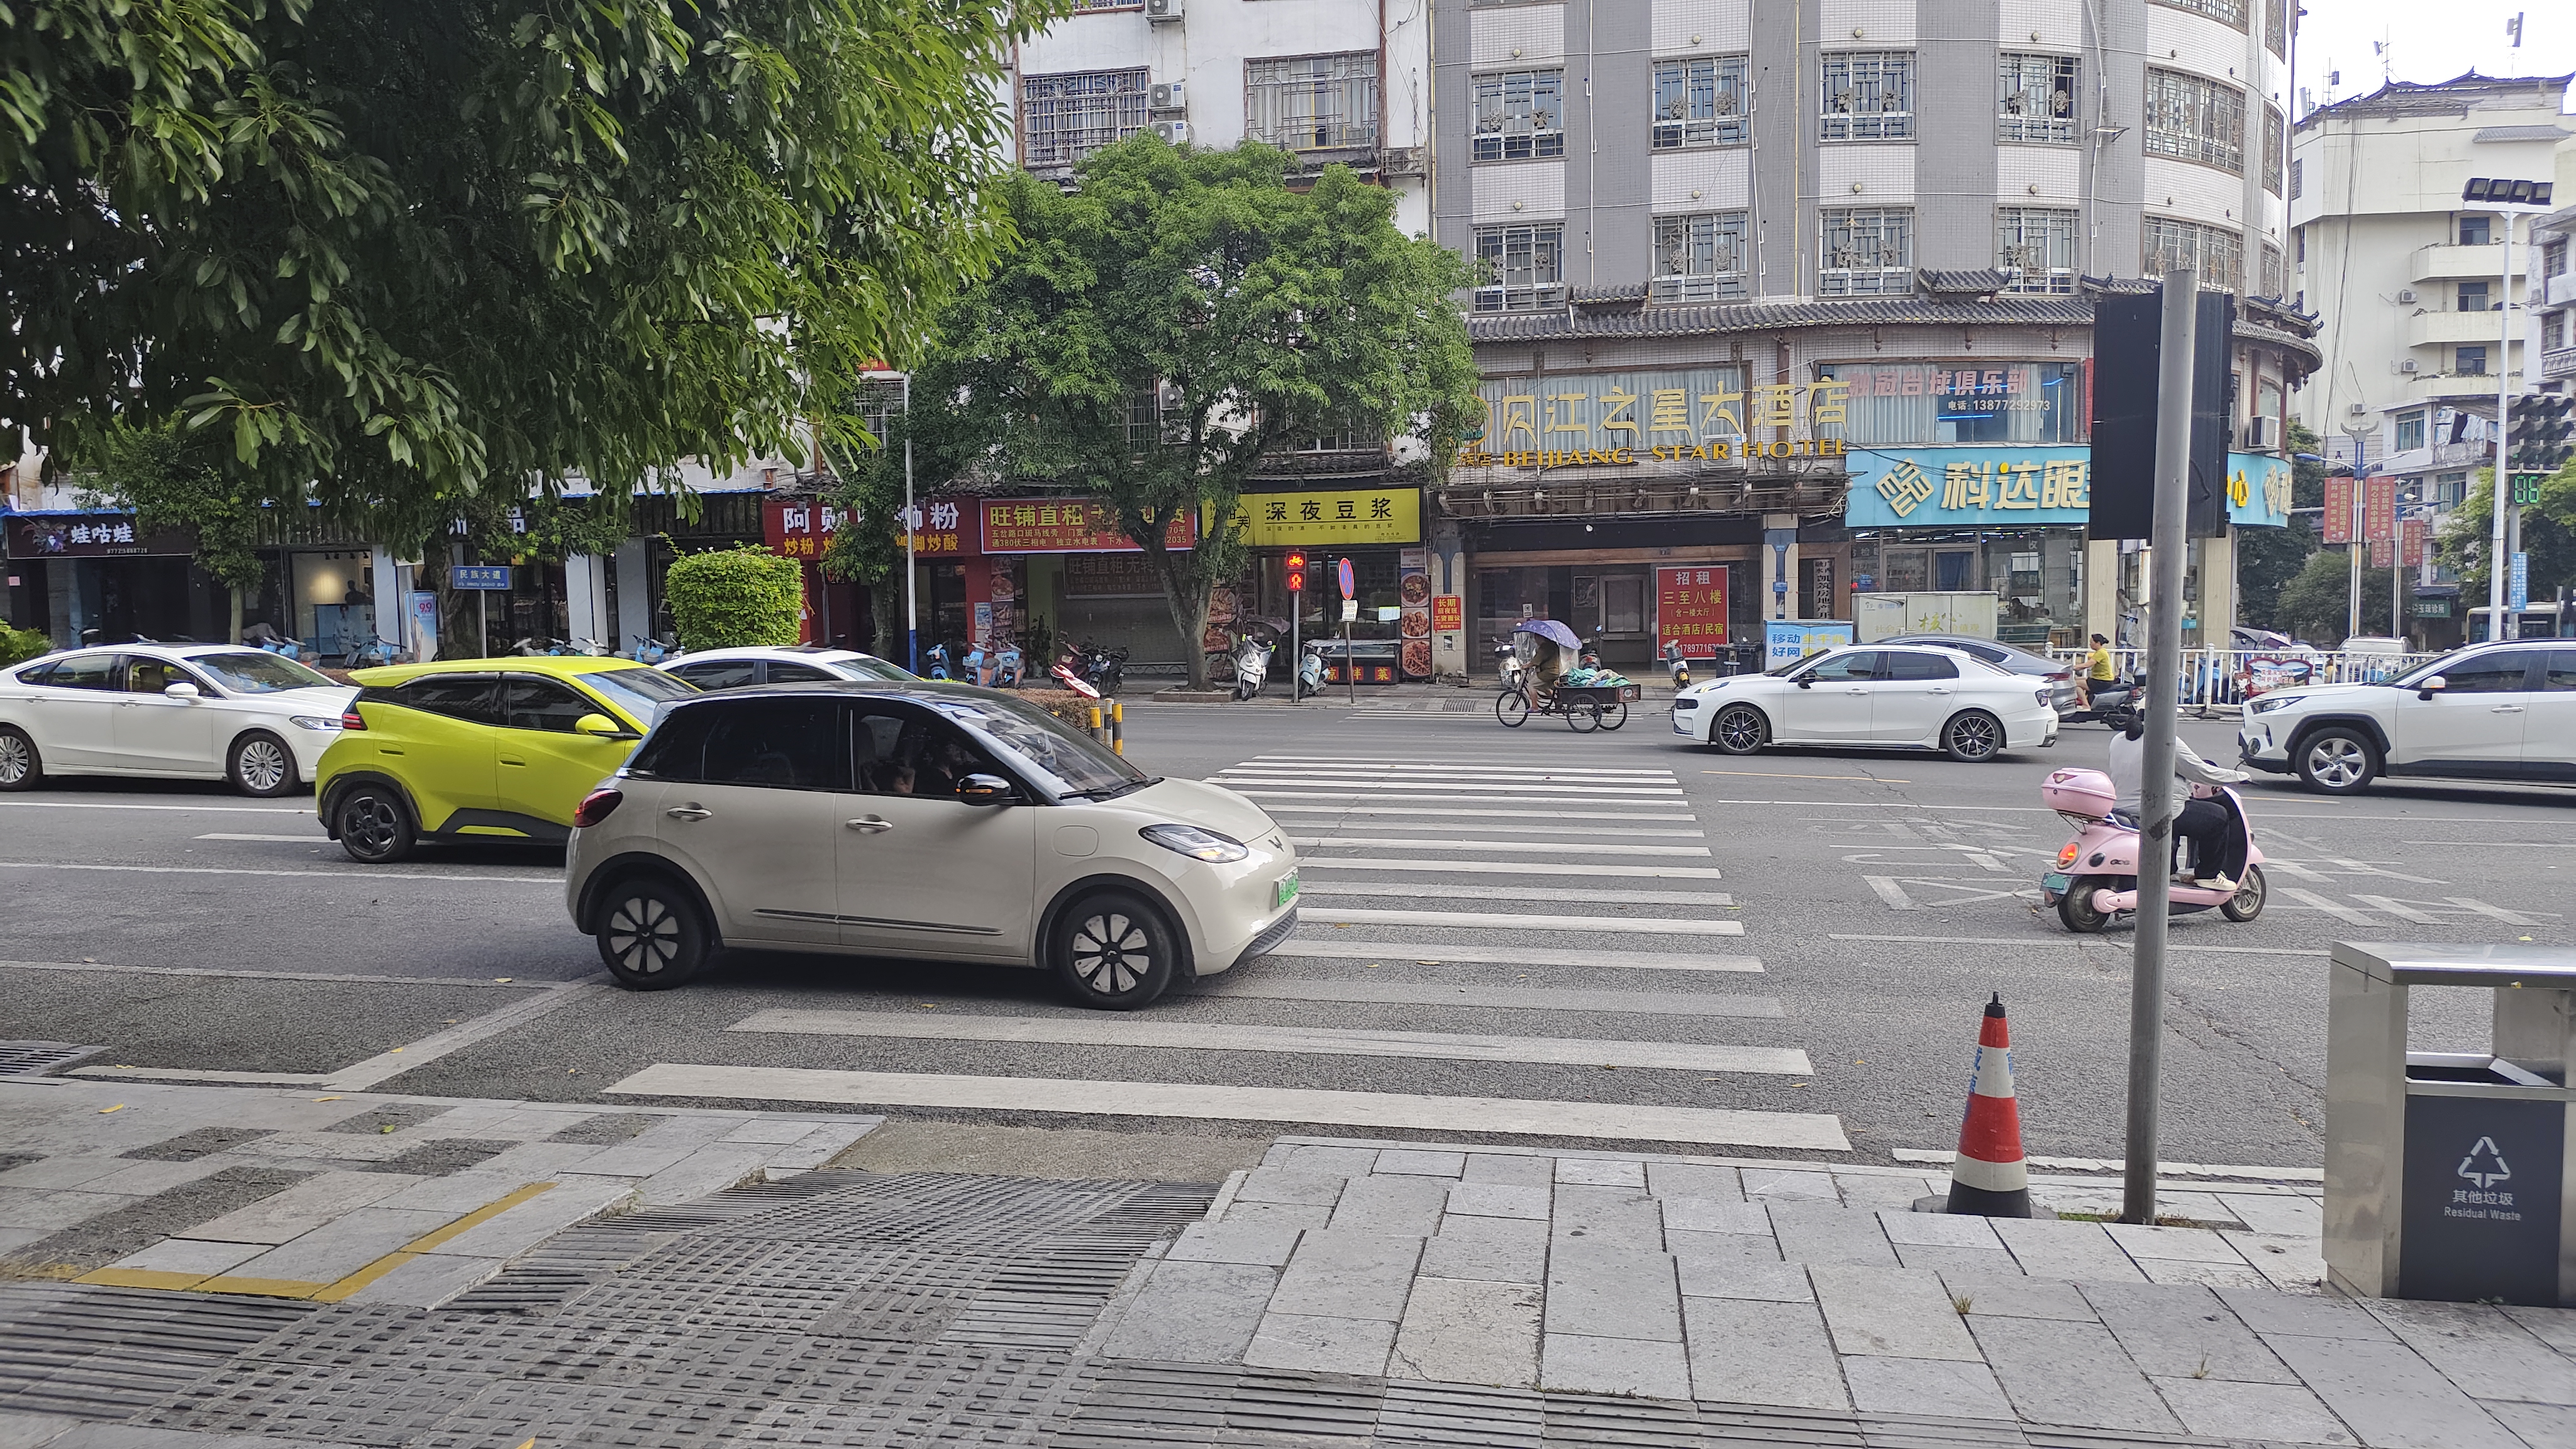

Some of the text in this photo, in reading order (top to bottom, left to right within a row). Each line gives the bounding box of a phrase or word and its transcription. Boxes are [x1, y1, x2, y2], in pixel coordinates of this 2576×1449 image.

[1504, 438, 1848, 467] BEIJIANG STAR HOTEL
[1941, 460, 2090, 510] 科达眼
[2514, 475, 2540, 503] 06
[990, 504, 1085, 526] 旺铺直租
[1265, 497, 1392, 521] 深夜豆浆
[70, 521, 135, 544] 蛙咕蛙
[460, 569, 501, 579] 民族大道
[1675, 570, 1711, 586] 招租
[1438, 598, 1456, 607] 长期
[1663, 589, 1722, 605] 三至八楼
[1662, 622, 1724, 636] 适合酒店/民宿
[2452, 1189, 2513, 1206] 其他垃圾
[2445, 1206, 2521, 1221] Residual Waste
